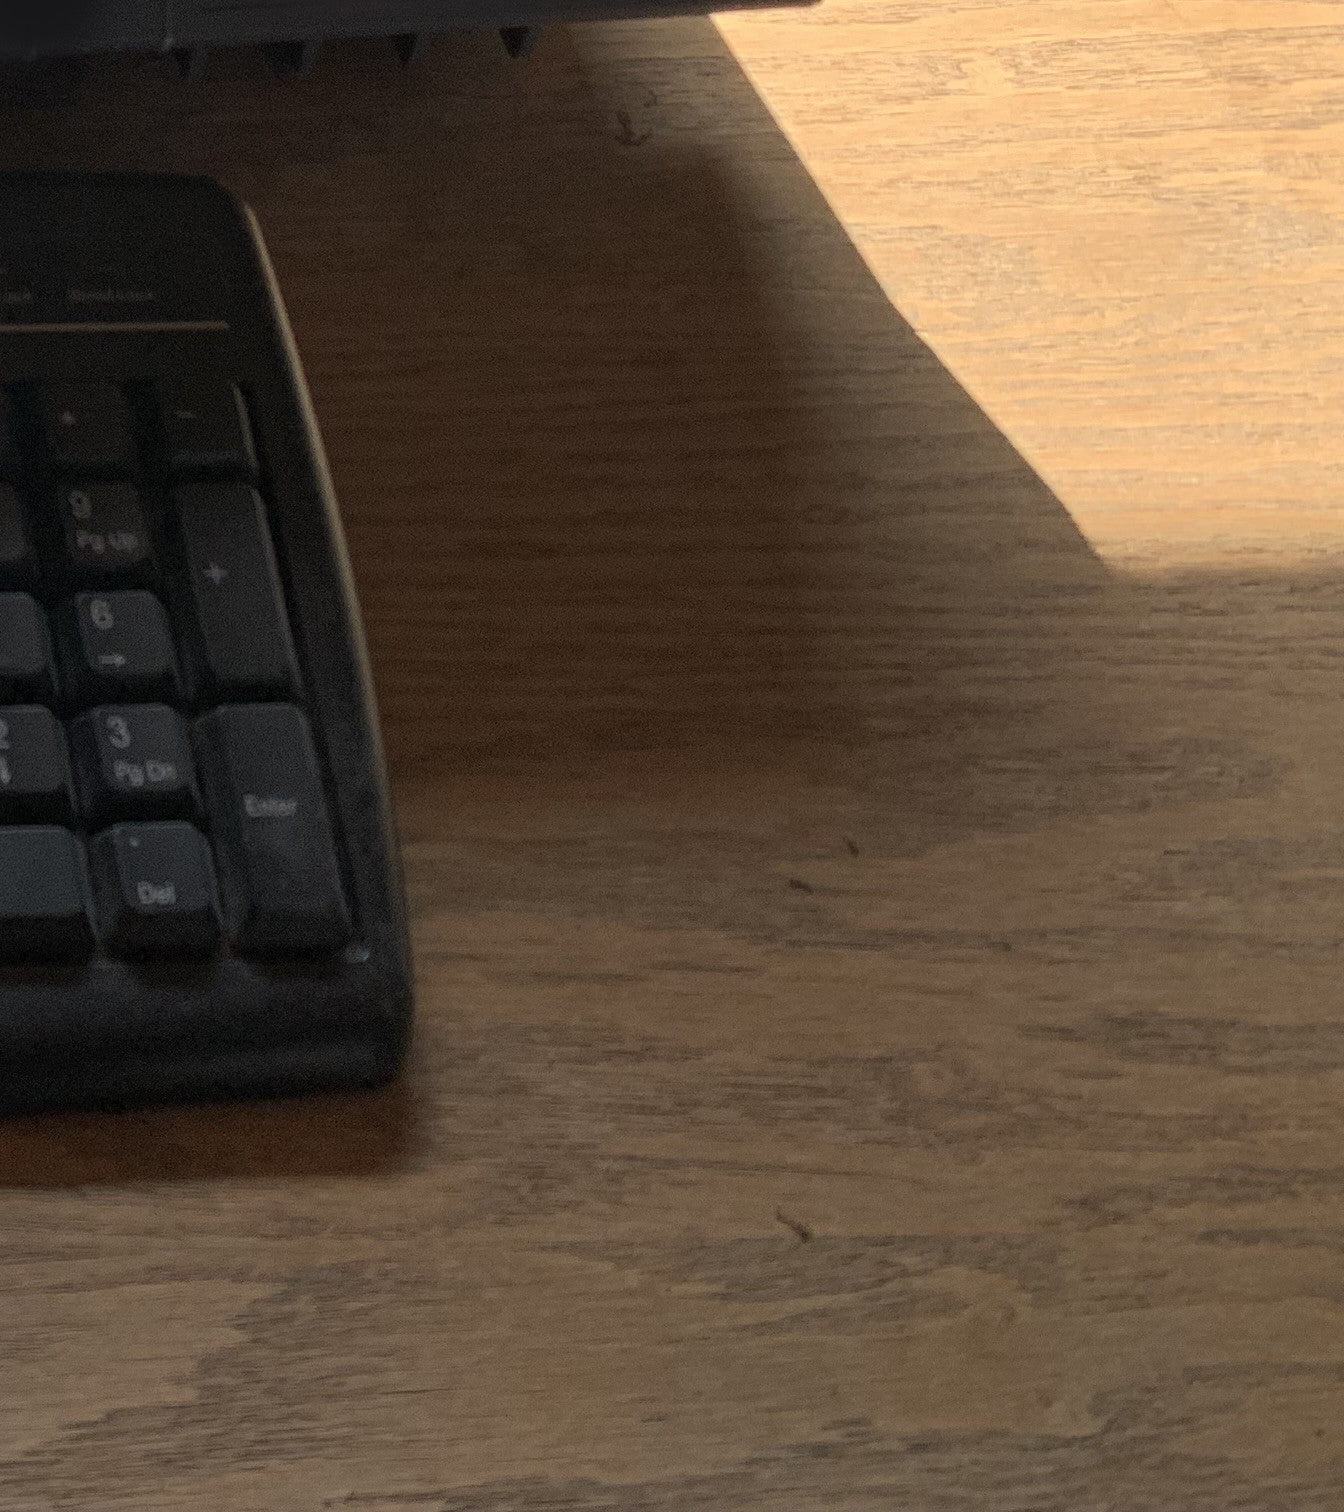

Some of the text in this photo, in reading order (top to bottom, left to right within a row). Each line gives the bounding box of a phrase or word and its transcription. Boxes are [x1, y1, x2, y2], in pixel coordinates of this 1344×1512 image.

[69, 489, 92, 520] 9
[90, 601, 114, 630] 6
[106, 716, 131, 748] 3
[113, 760, 177, 788] Pg Dn
[243, 794, 297, 818] Enter
[138, 881, 175, 905] Del
